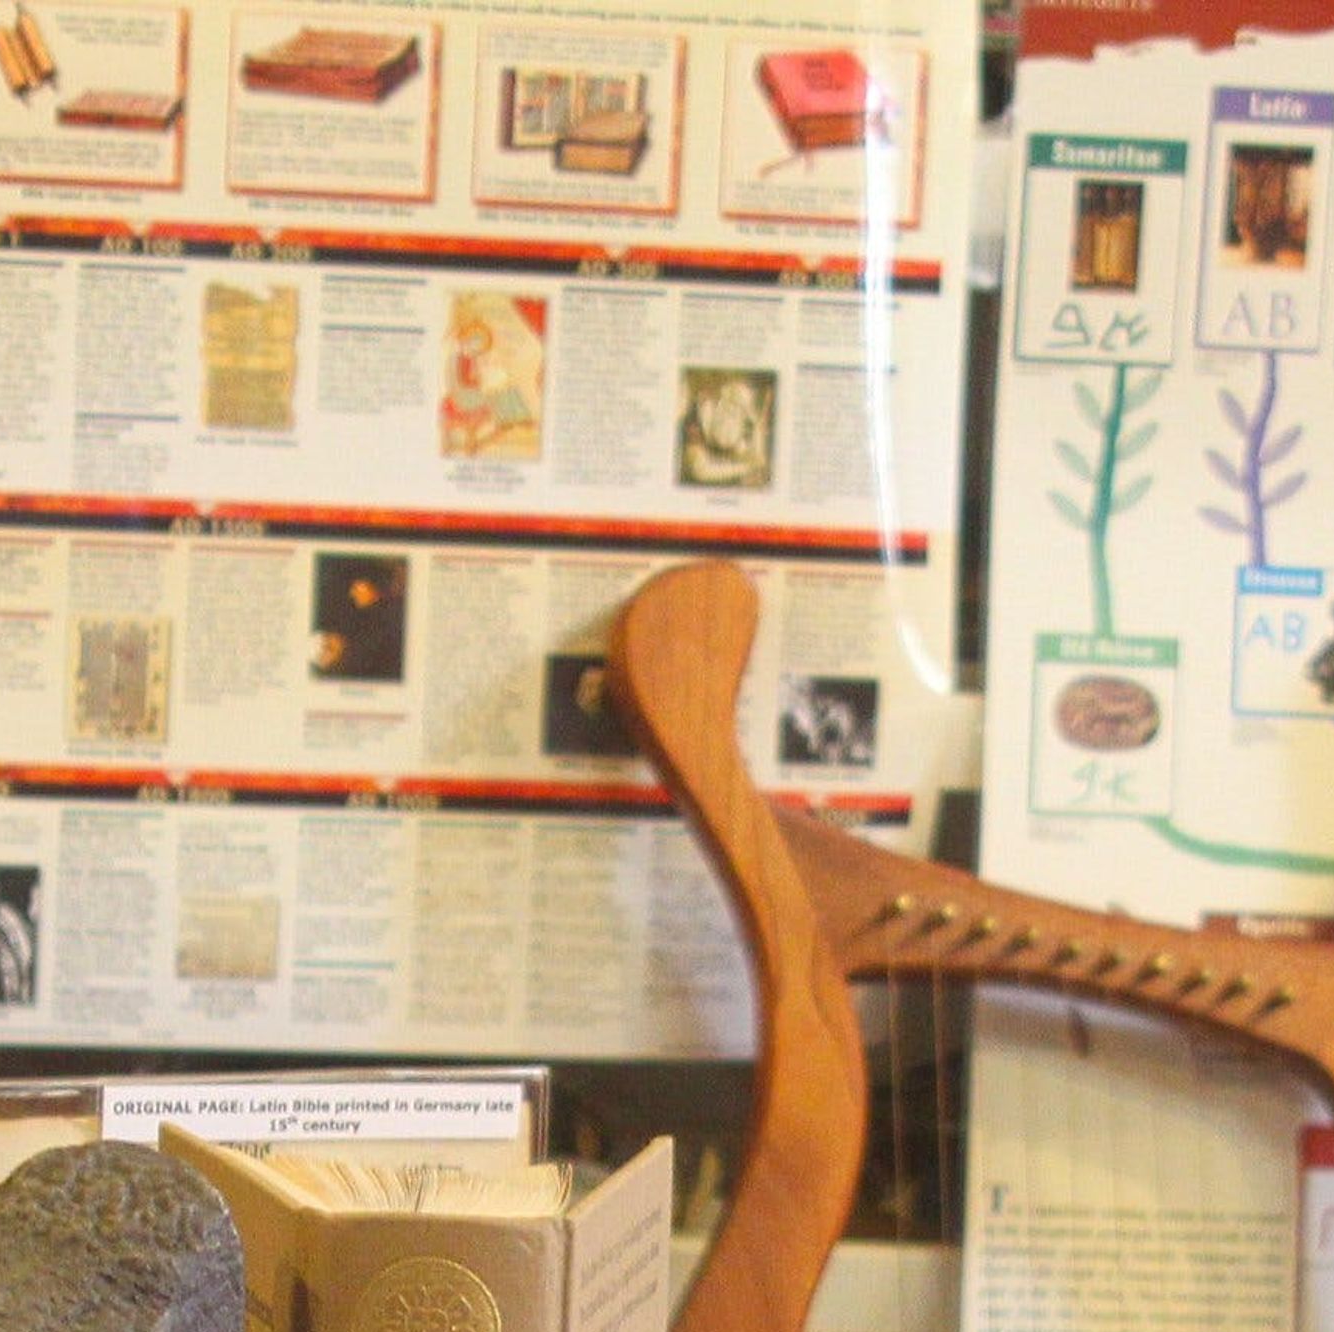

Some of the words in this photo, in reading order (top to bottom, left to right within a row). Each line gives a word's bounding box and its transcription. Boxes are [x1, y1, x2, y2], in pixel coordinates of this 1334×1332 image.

[1248, 93, 1310, 120] Latin
[1051, 143, 1161, 169] Samaritan
[112, 1100, 193, 1116] ORIGINAL
[198, 1100, 244, 1115] PAGE:
[248, 1097, 287, 1114] Latin
[292, 1096, 331, 1113] Bible
[334, 1097, 391, 1117] printed
[394, 1096, 410, 1112] in
[413, 1096, 481, 1116] Germany
[485, 1096, 515, 1113] late
[302, 1118, 362, 1134] century
